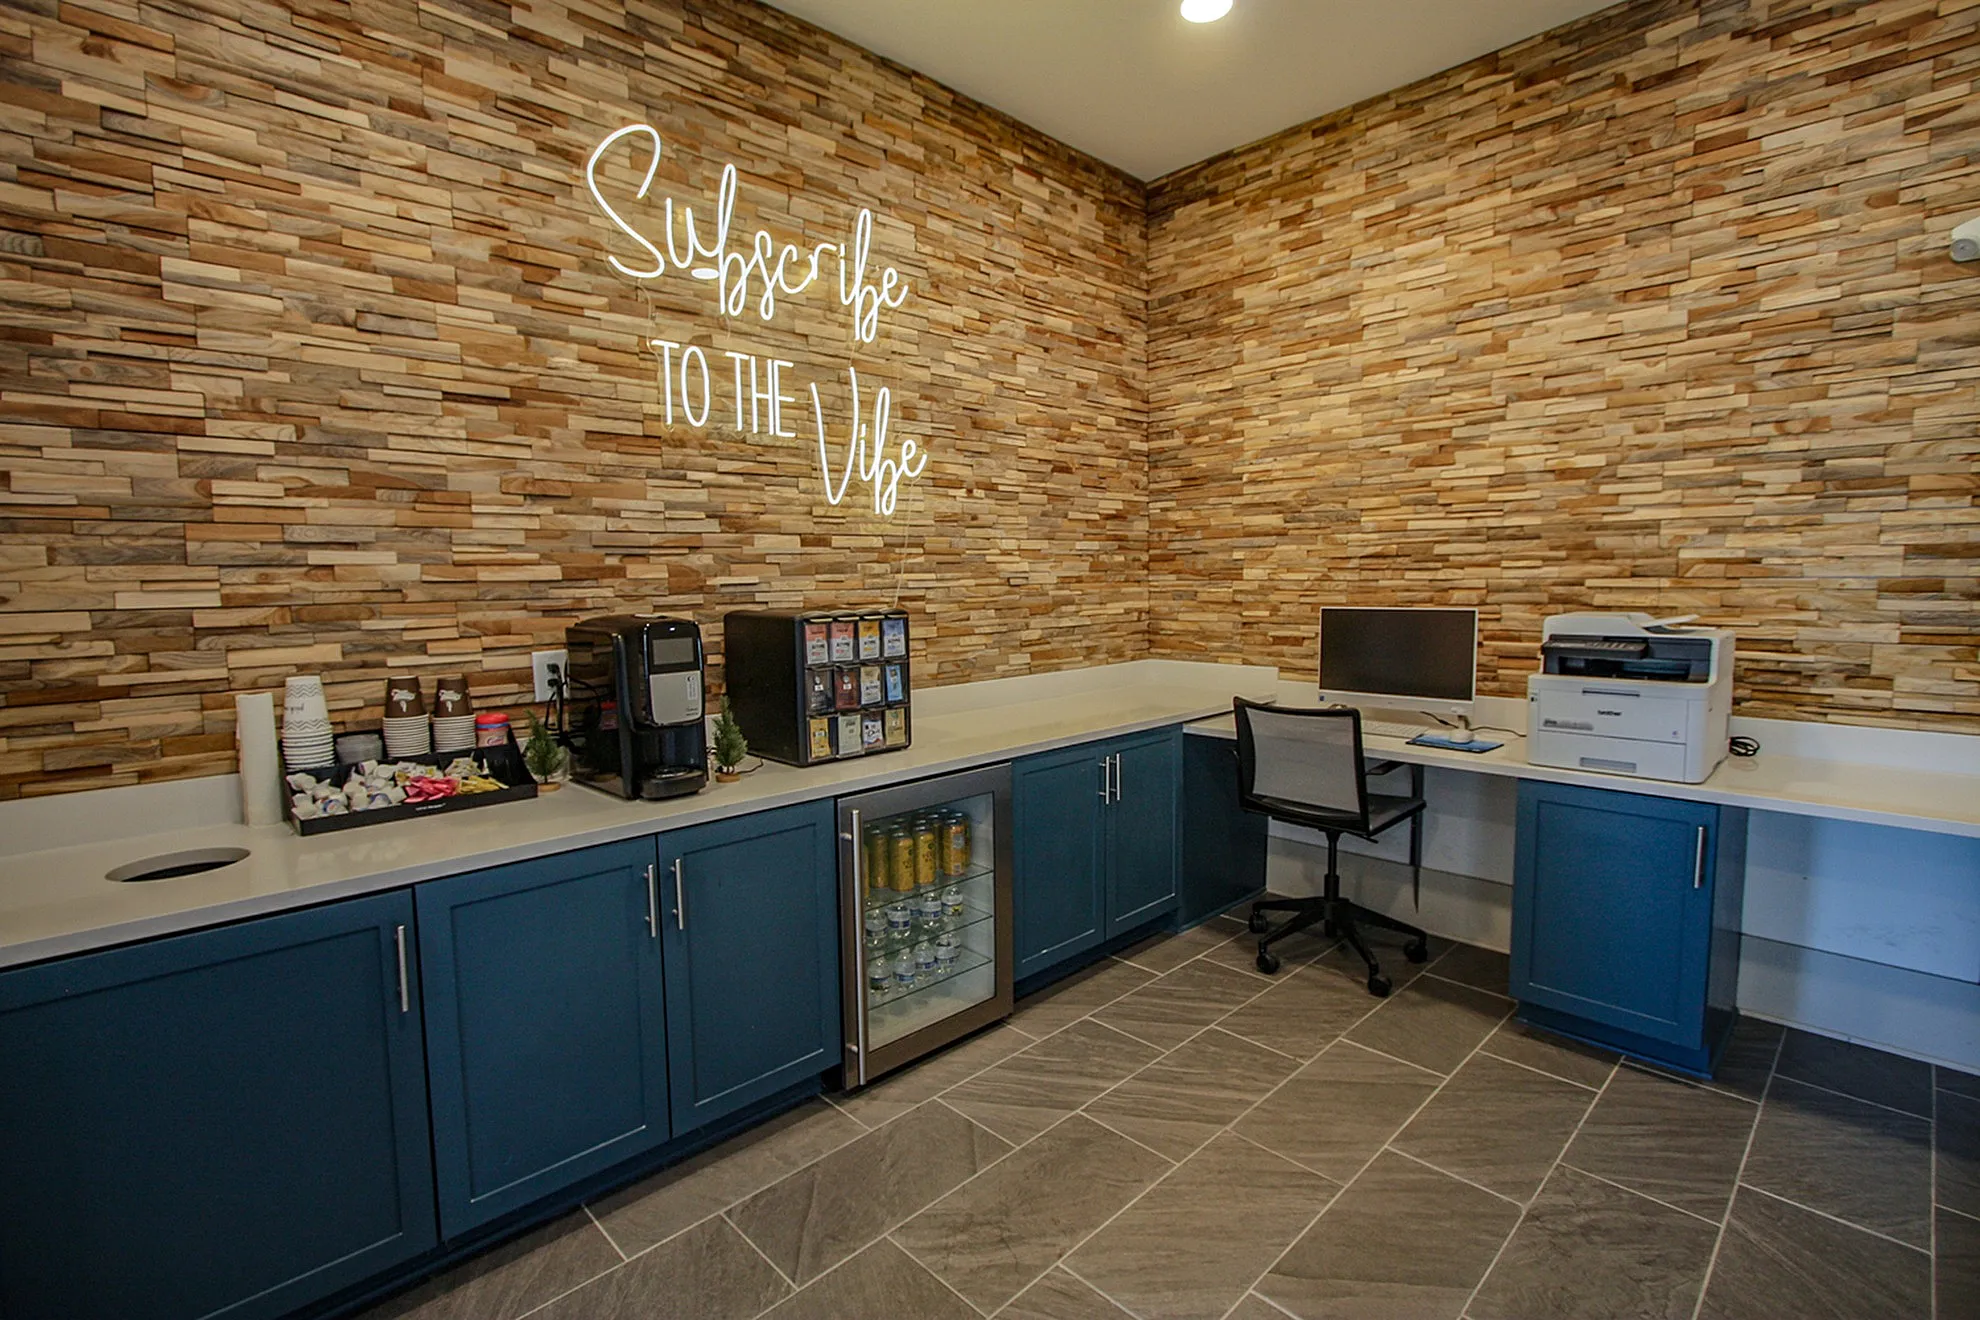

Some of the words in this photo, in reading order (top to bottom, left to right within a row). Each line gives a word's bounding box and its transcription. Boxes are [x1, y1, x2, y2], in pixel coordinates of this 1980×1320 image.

[586, 123, 910, 344] Subscribe
[651, 339, 710, 428] TO
[725, 351, 797, 438] THE
[810, 366, 928, 517] Vibe
